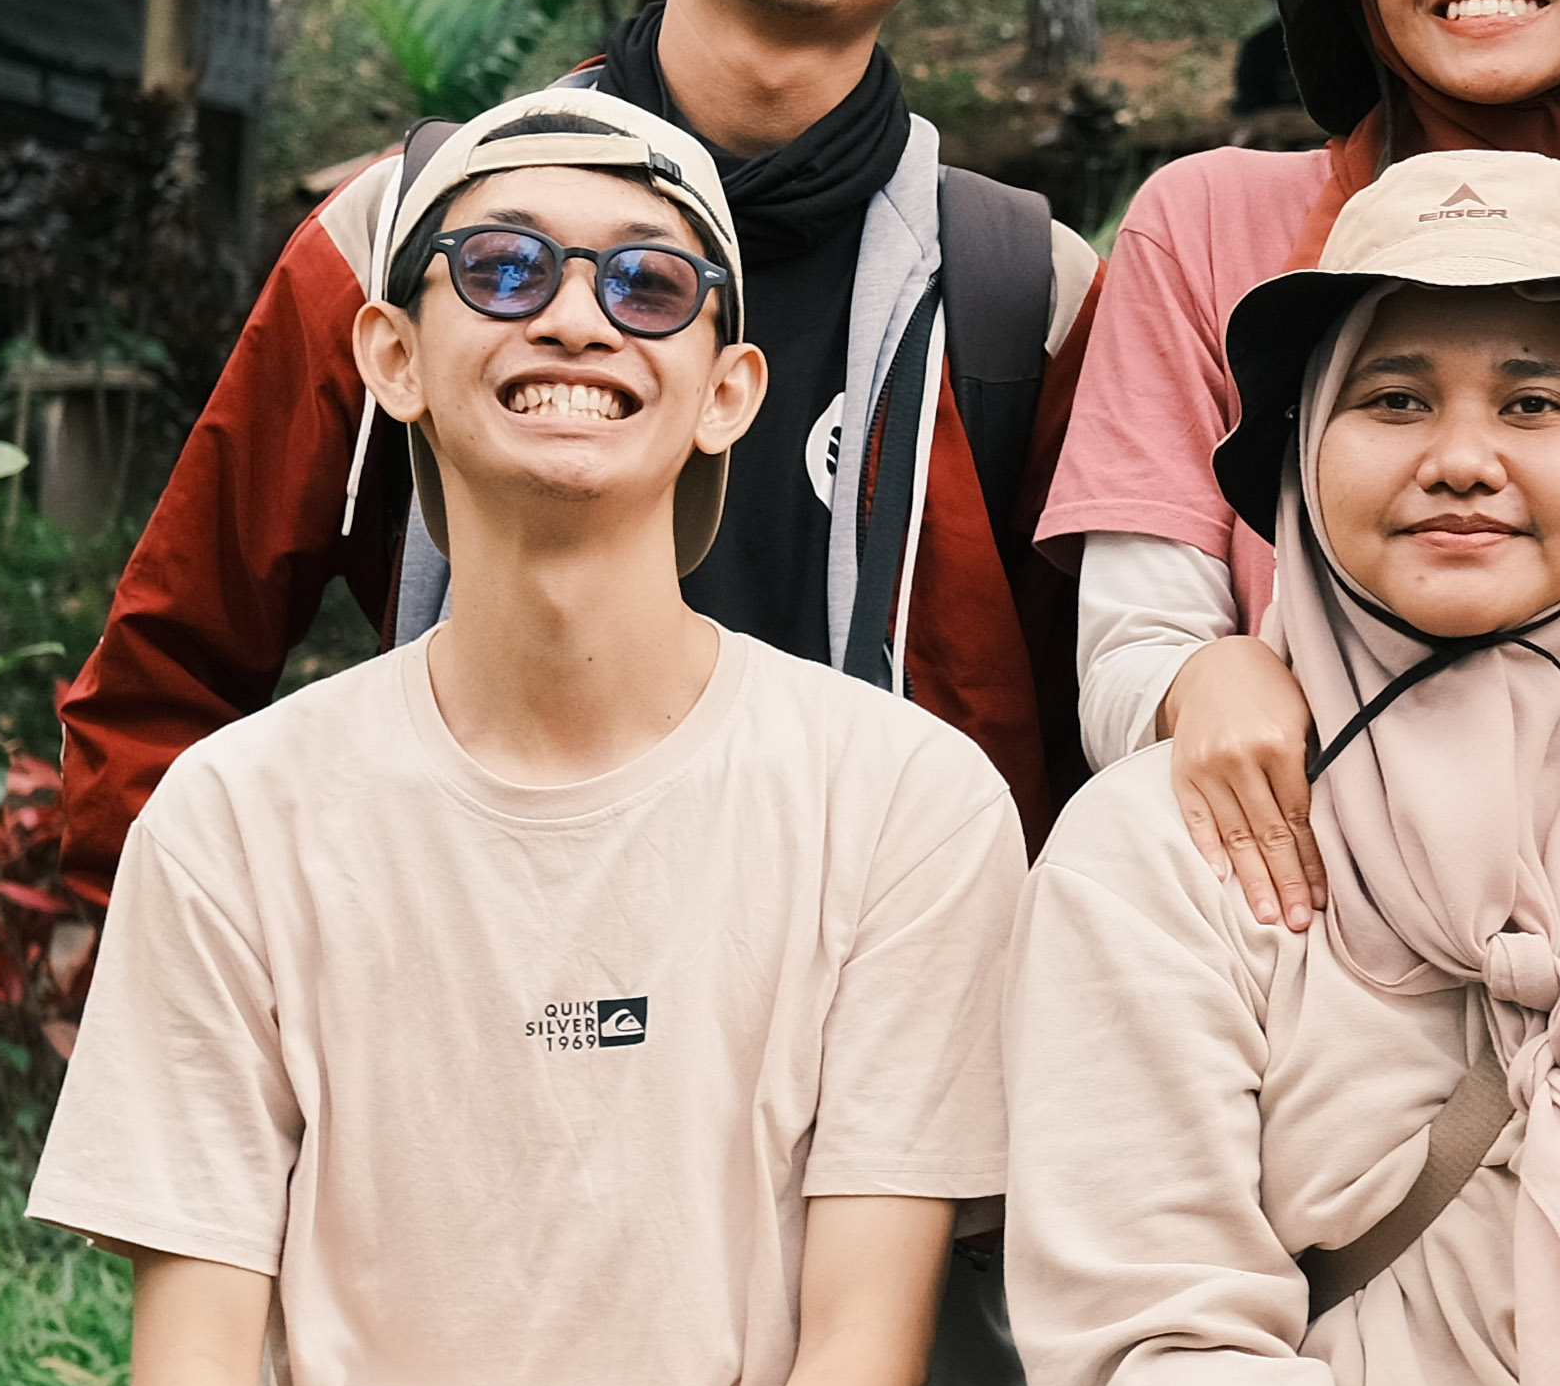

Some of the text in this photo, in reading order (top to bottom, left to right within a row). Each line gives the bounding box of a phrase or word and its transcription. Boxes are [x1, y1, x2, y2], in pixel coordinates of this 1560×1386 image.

[1418, 209, 1508, 223] EIGER
[544, 1000, 595, 1018] QUIK
[525, 1017, 596, 1037] SILVER
[547, 1033, 597, 1052] 1969
